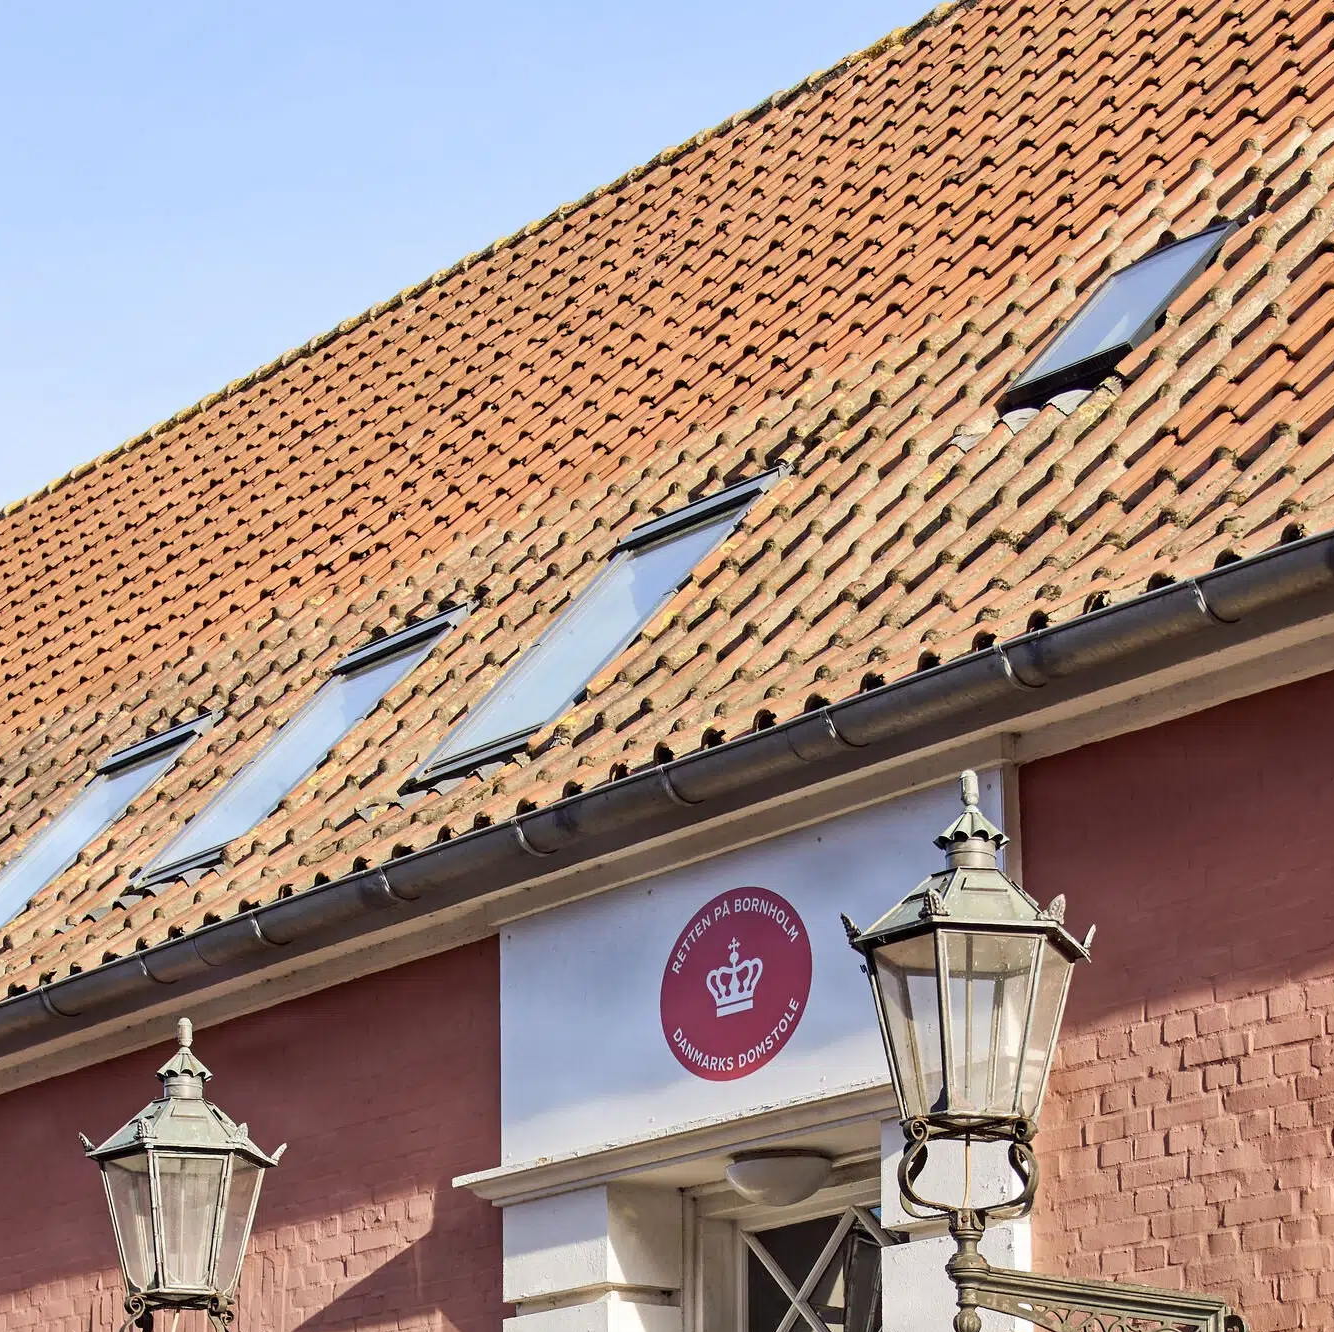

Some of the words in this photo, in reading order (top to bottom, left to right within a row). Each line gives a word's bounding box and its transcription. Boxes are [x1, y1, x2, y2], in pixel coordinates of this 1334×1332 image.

[672, 914, 711, 974] RETTEN
[714, 900, 730, 921] PÅ
[734, 897, 799, 942] BORNHOLM
[673, 1027, 734, 1071] DANMARKS
[738, 997, 799, 1067] DOMSTOLE
